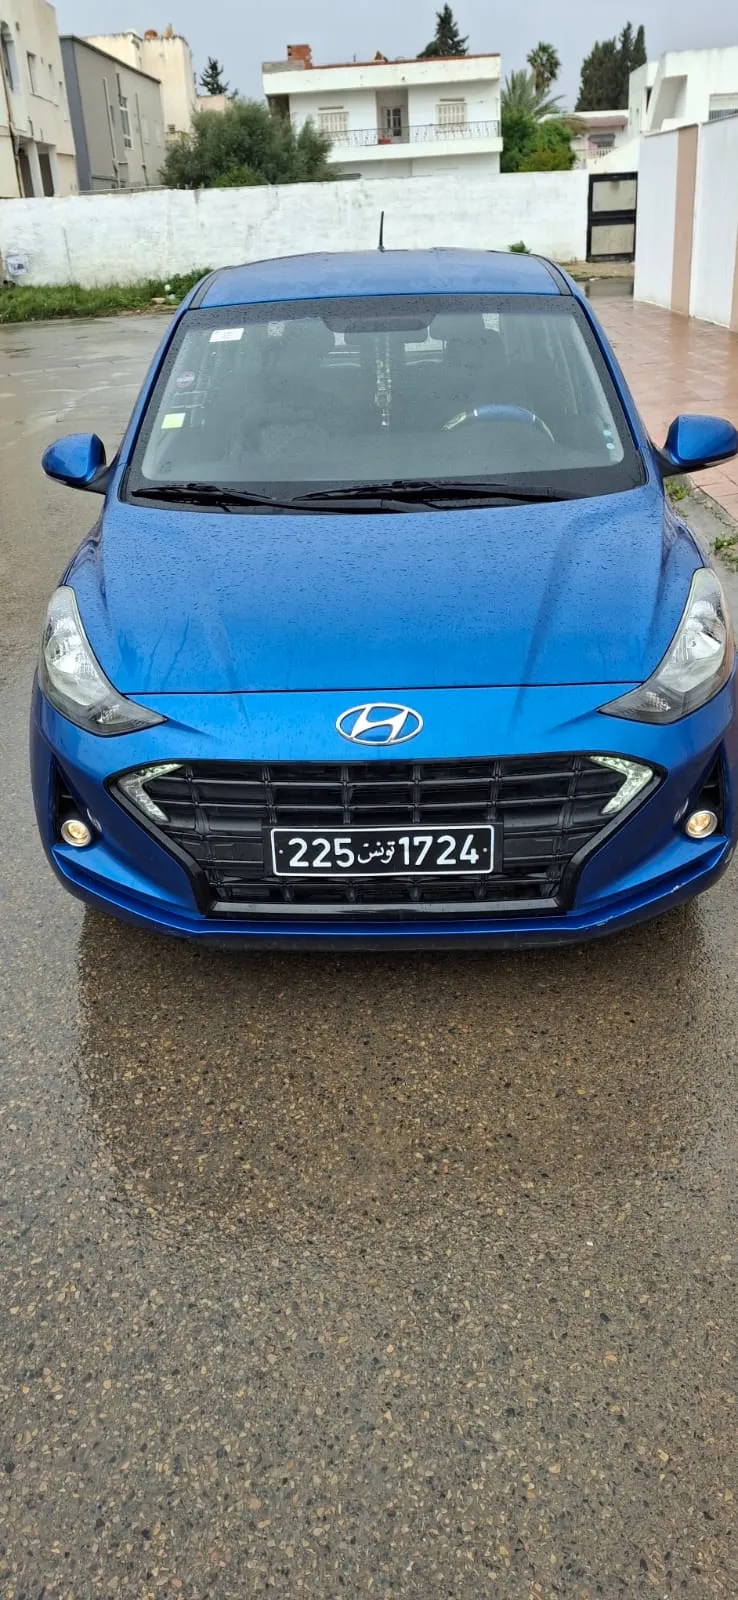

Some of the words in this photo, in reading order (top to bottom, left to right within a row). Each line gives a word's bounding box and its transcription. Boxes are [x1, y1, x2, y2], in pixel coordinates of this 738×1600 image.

[288, 837, 355, 868] 225
[357, 840, 396, 864] تونس
[398, 834, 480, 865] 1724
